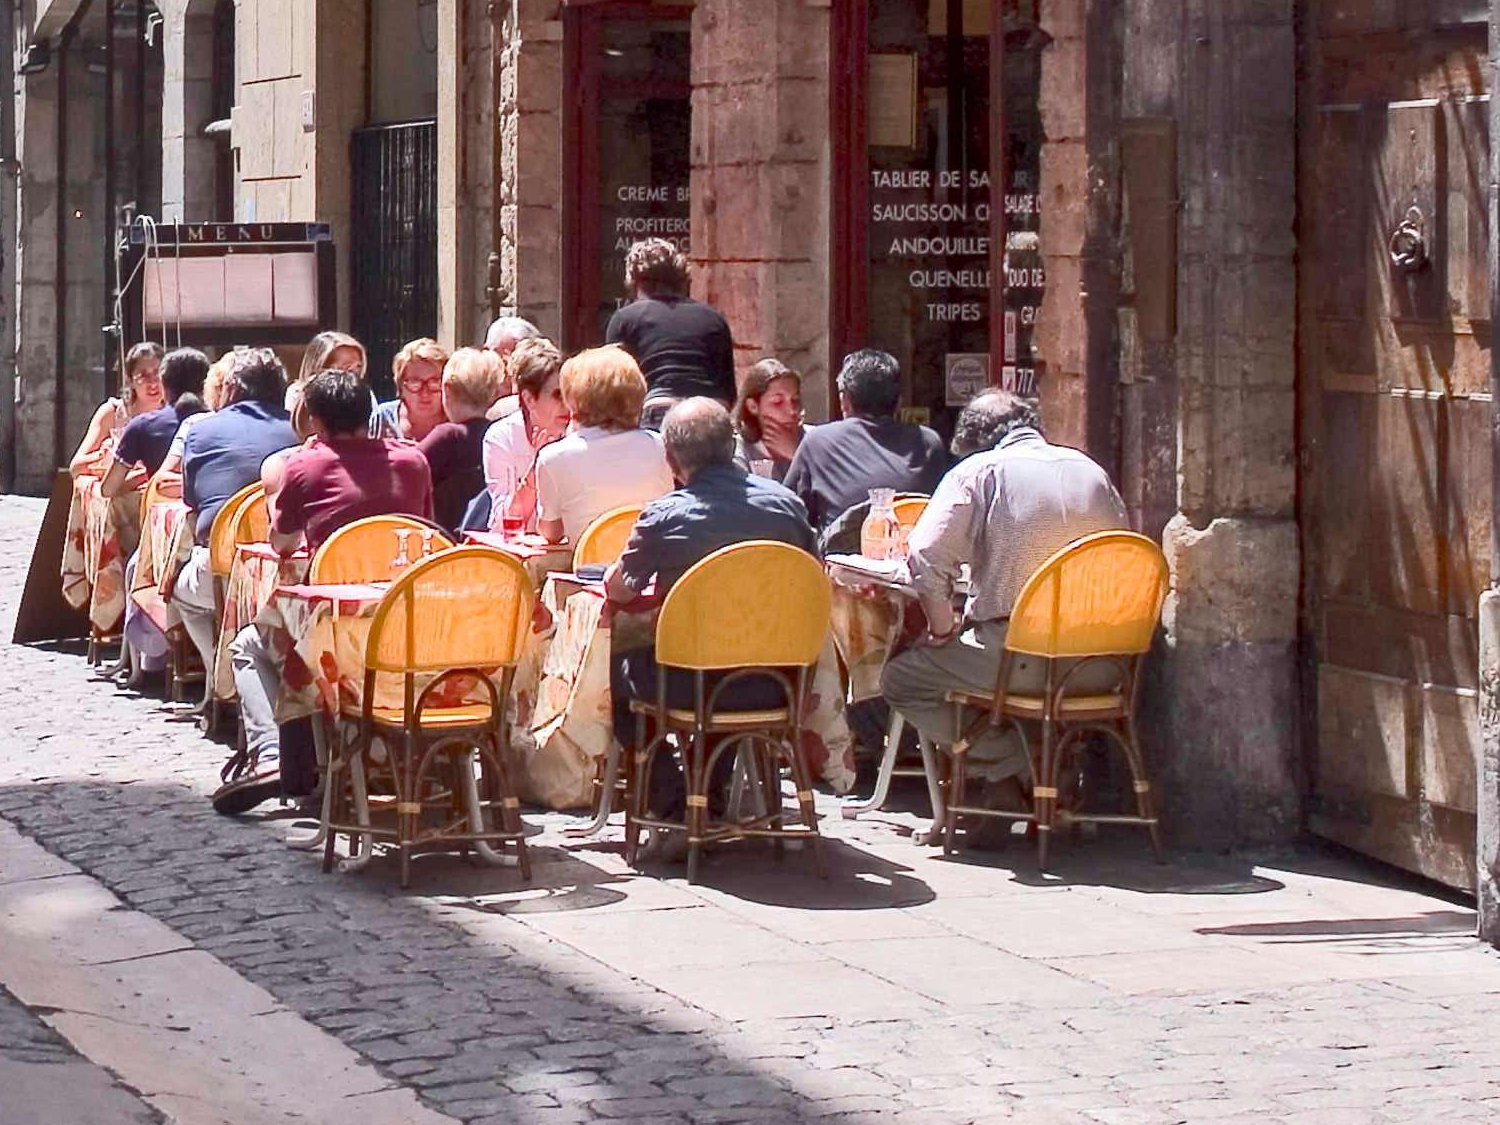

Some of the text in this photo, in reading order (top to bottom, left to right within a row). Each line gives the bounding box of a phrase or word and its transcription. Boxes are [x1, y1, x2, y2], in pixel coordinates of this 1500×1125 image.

[871, 170, 931, 188] TABLIER
[940, 170, 960, 188] DE
[617, 186, 669, 202] CREME
[872, 203, 966, 222] SAUCISSON
[187, 226, 274, 242] MENU
[926, 303, 981, 322] TRIPES
